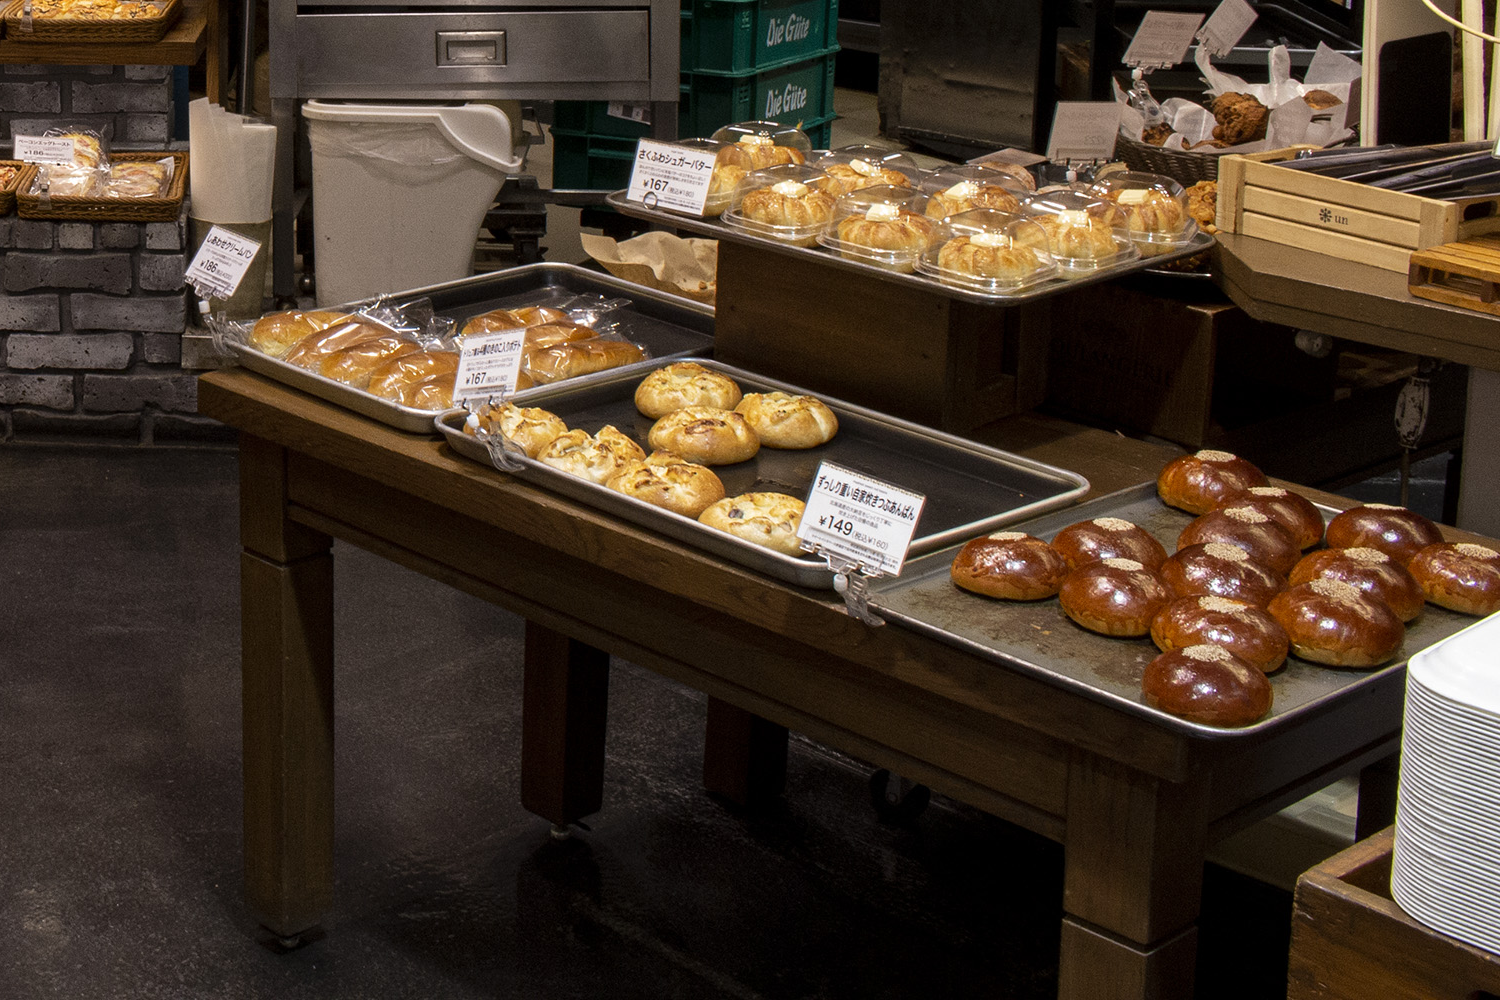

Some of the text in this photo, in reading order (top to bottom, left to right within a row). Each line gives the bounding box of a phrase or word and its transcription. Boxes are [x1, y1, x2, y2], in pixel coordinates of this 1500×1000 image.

[766, 12, 810, 47] Die Güte
[765, 83, 807, 119] Die Güte
[19, 139, 70, 147] ベーコンエッグトースト
[638, 148, 712, 171] さくふわシュガーバター
[642, 177, 669, 192] ¥167
[1334, 215, 1349, 225] un
[206, 233, 254, 259] しあわせクリームパン
[200, 259, 218, 273] ¥186
[466, 372, 487, 384] ¥167
[818, 475, 915, 521] ずっしり重い自家炊きつぶあんぱん
[818, 514, 890, 551] ¥149 (税込¥160)
